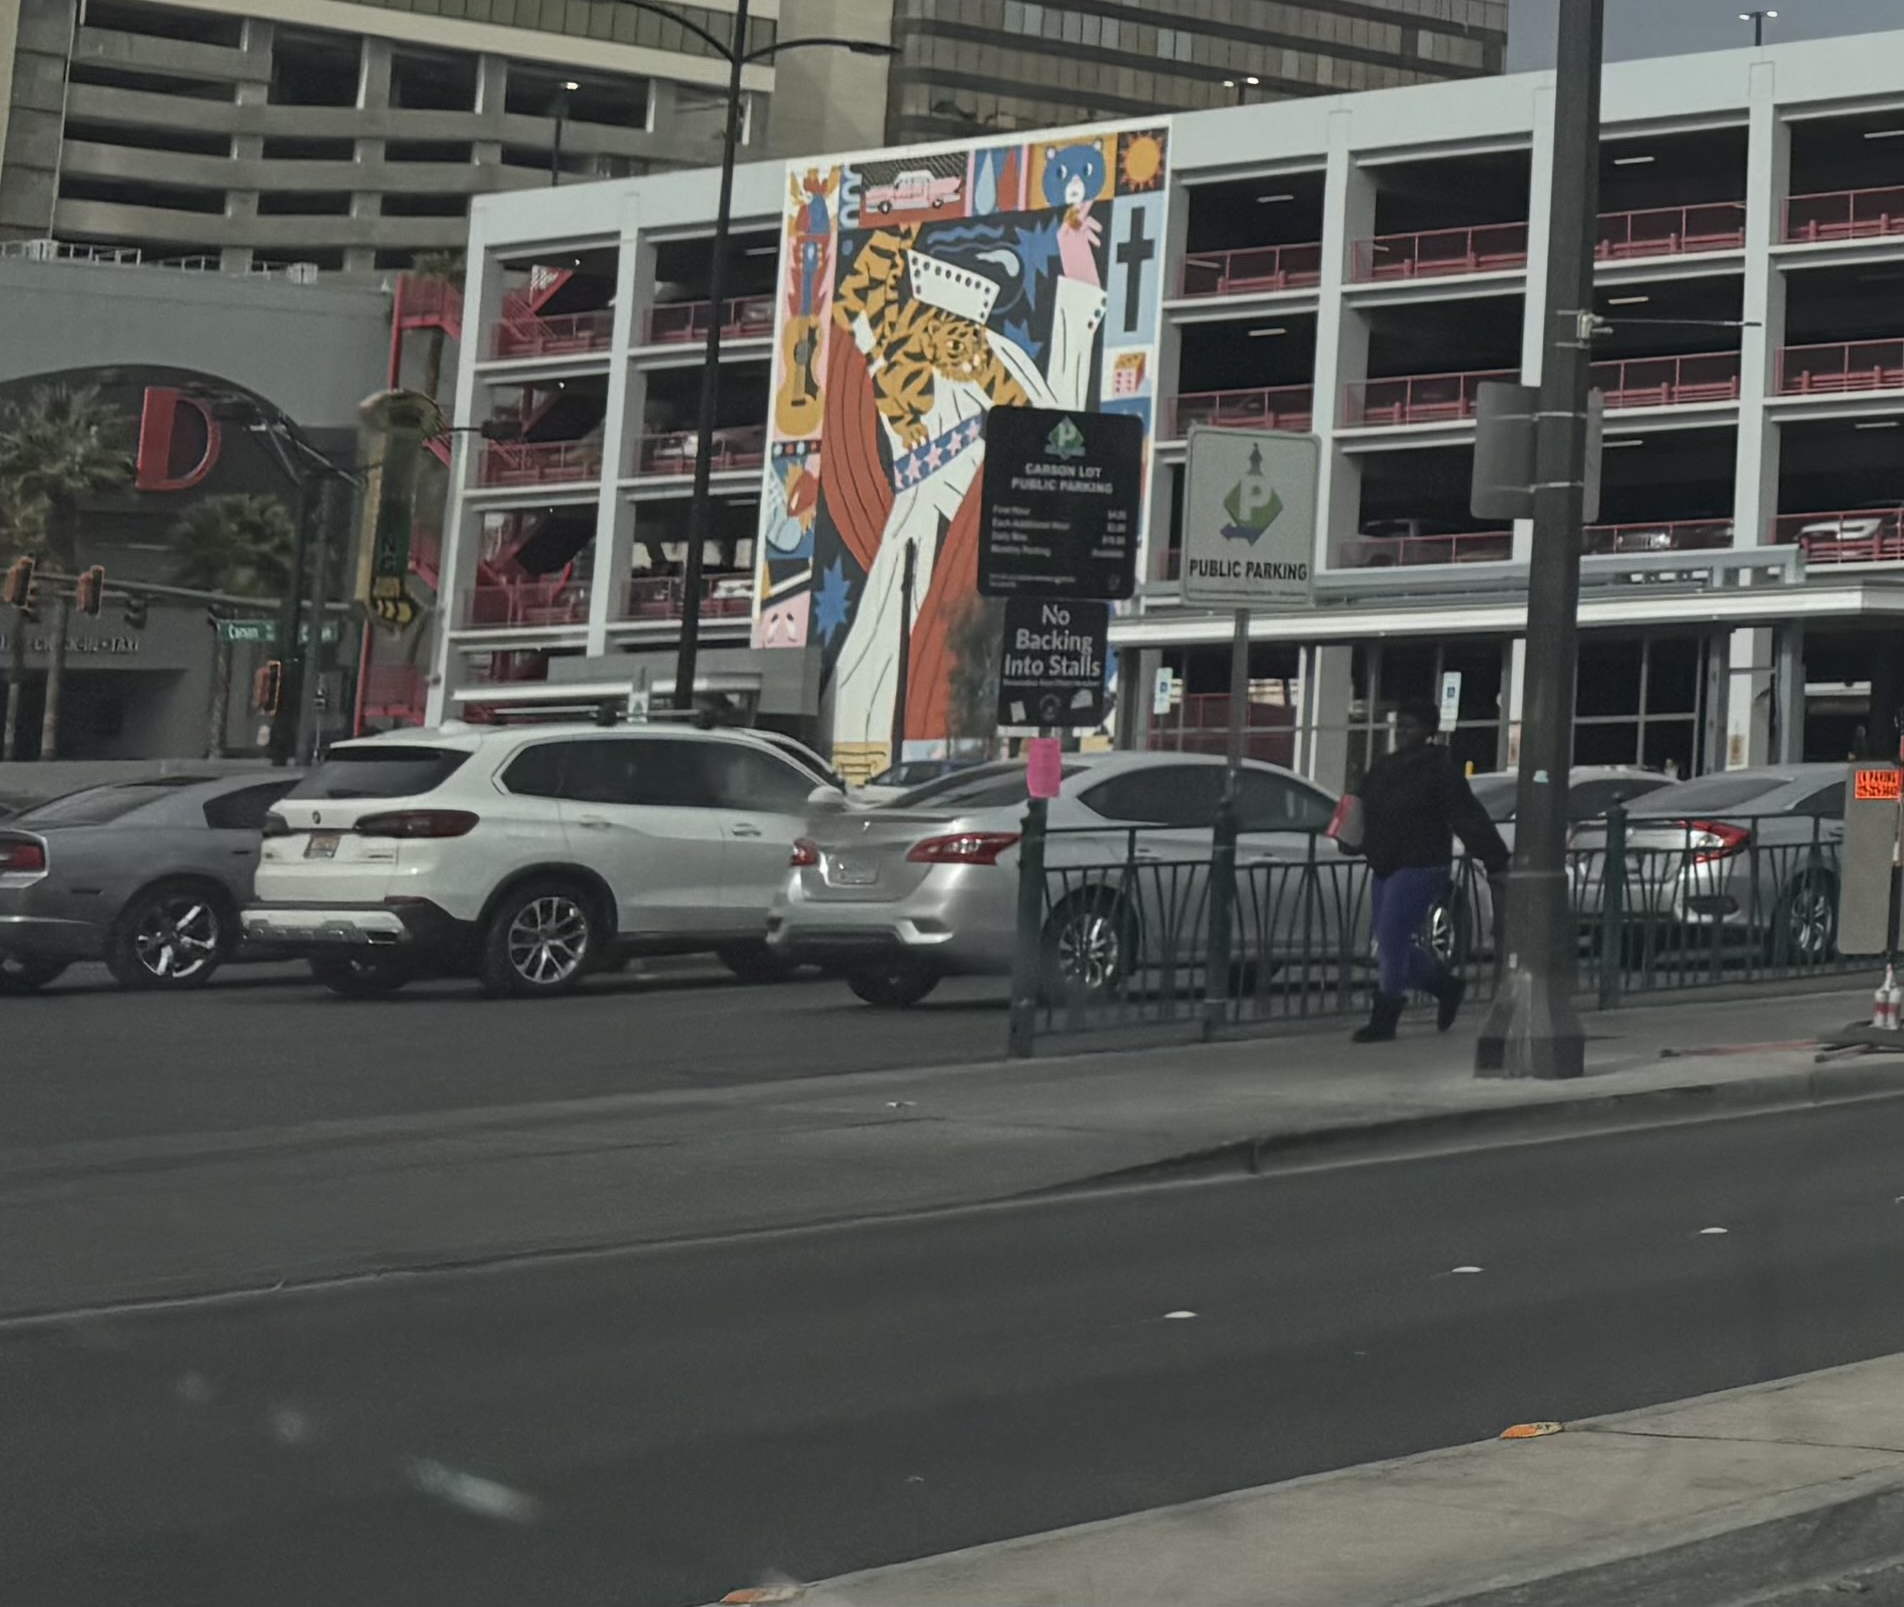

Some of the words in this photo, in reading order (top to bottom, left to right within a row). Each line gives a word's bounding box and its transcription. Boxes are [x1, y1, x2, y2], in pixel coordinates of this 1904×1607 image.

[136, 386, 222, 490] D
[1025, 463, 1076, 477] CARSON
[1079, 465, 1102, 478] LOT
[1011, 477, 1056, 491] PUBLIC
[1060, 480, 1113, 494] PARKING
[1189, 559, 1241, 578] PUBLIC
[1245, 561, 1307, 581] PARKING
[1042, 604, 1070, 625] No
[1016, 628, 1093, 654] Backing
[1004, 653, 1044, 676] Into
[1049, 655, 1101, 676] Stalls
